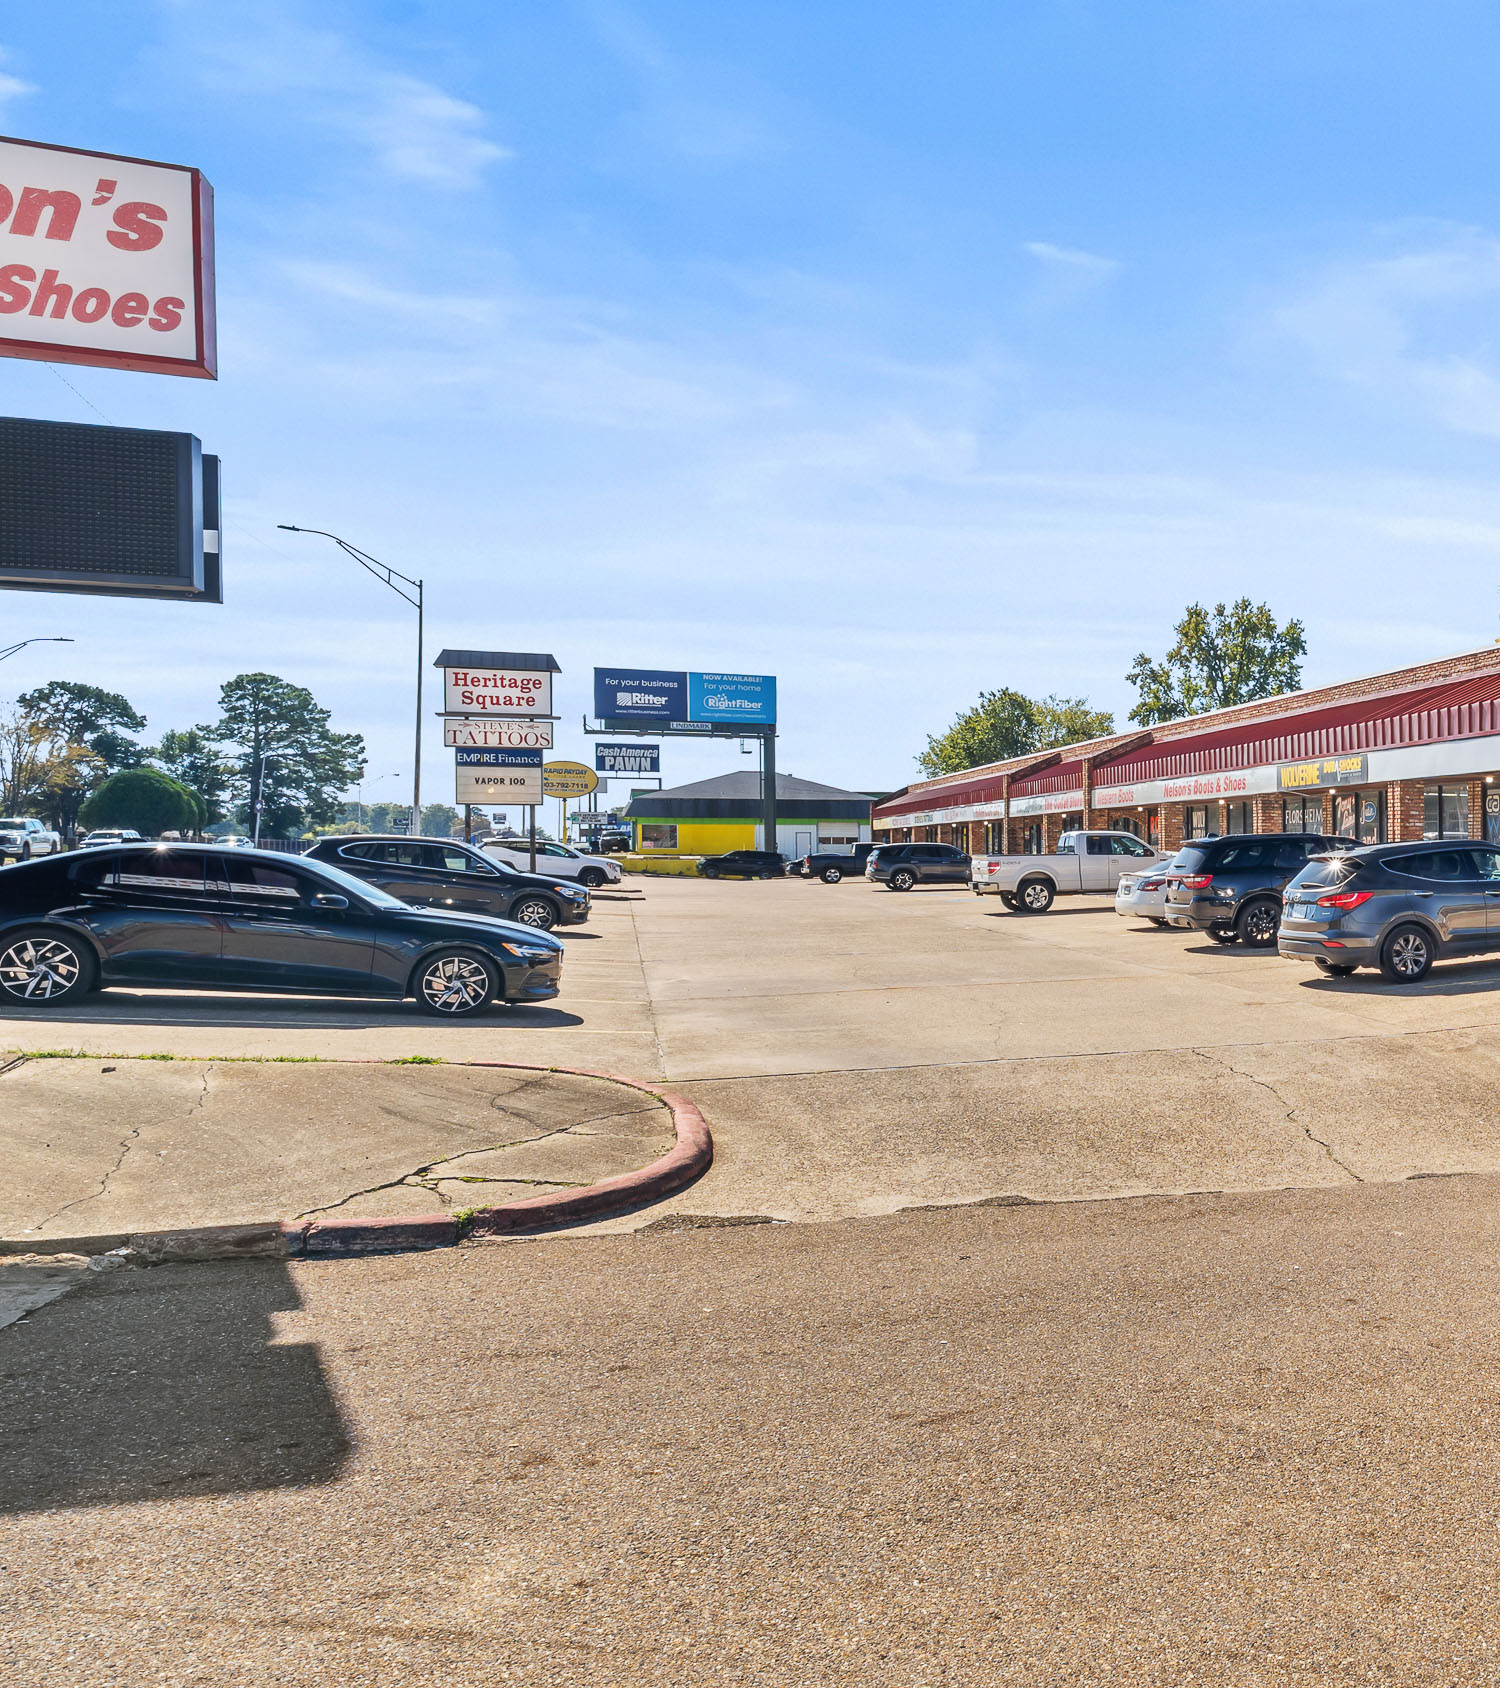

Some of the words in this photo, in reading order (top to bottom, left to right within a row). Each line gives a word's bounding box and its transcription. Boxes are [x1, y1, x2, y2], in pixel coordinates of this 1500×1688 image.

[0, 264, 185, 332] Shoes
[452, 672, 542, 693] Heritage
[605, 677, 619, 685] For
[641, 680, 678, 688] business
[723, 675, 763, 683] AVAILABLE!
[461, 690, 536, 709] Square
[632, 692, 669, 705] Ritter
[474, 721, 524, 730] STEVE'S
[447, 729, 550, 746] TATTOOS
[457, 752, 497, 763] EMPIRE
[498, 754, 540, 763] Finance
[604, 757, 651, 771] PAWN
[474, 777, 505, 785] VAPOR
[1281, 763, 1320, 788] WOLVERINE
[1164, 782, 1191, 798] Nelson's
[1193, 780, 1214, 795] Boots
[1215, 778, 1221, 793] &
[1223, 776, 1247, 792] Shoes
